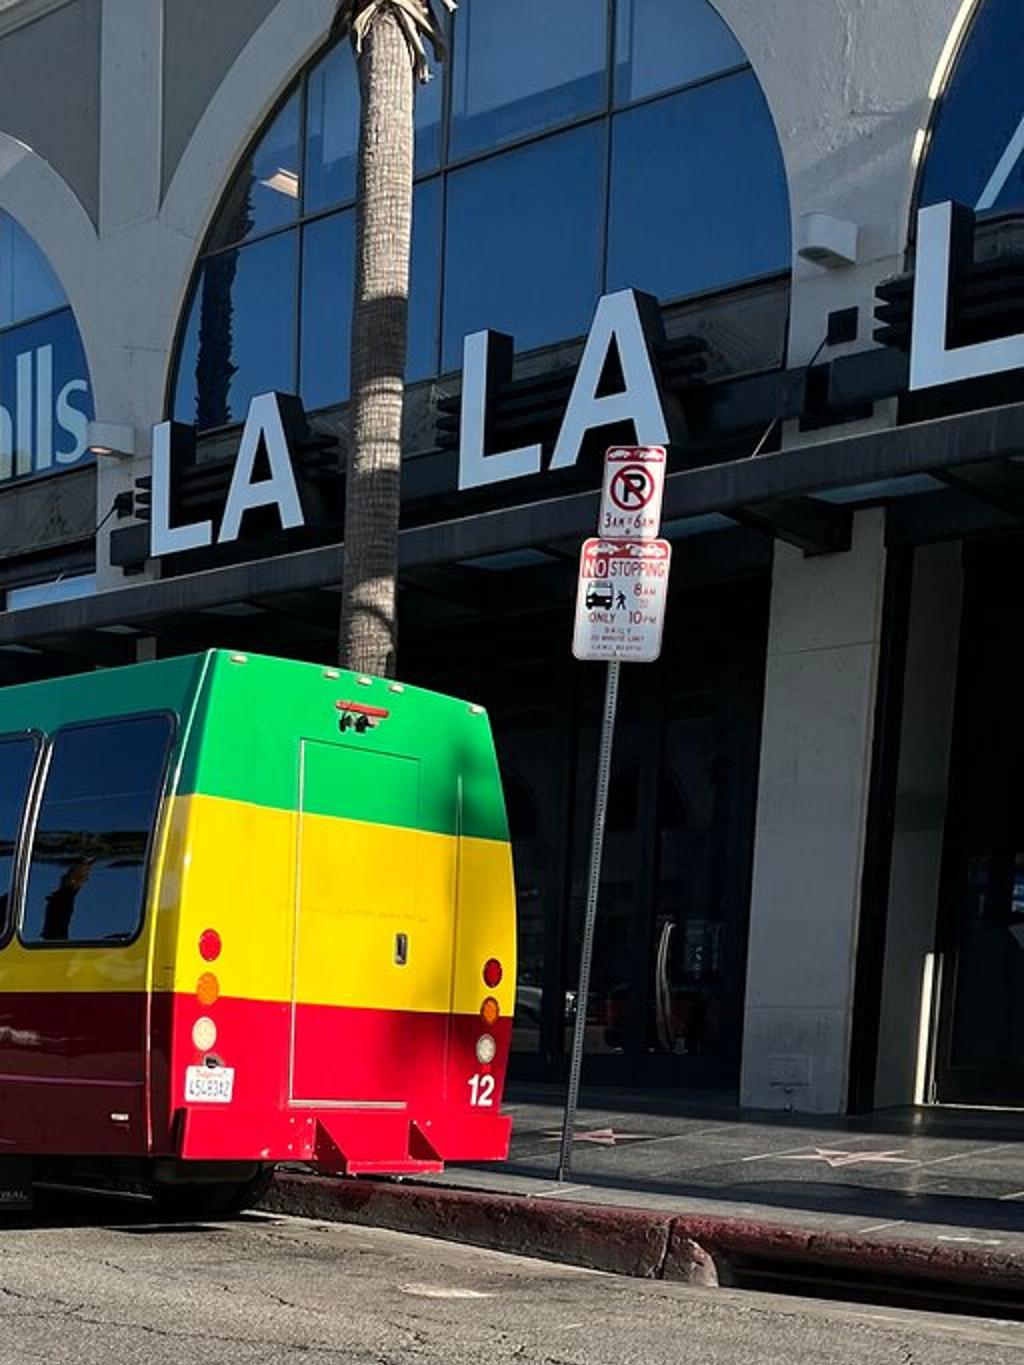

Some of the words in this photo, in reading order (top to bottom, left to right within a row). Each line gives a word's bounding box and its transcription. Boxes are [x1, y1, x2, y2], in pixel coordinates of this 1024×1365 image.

[150, 391, 305, 557] LA
[457, 287, 670, 491] LA
[583, 559, 607, 577] NO
[610, 561, 666, 577] STOPPING
[589, 612, 615, 624] ONLY
[467, 1073, 495, 1107] 12
